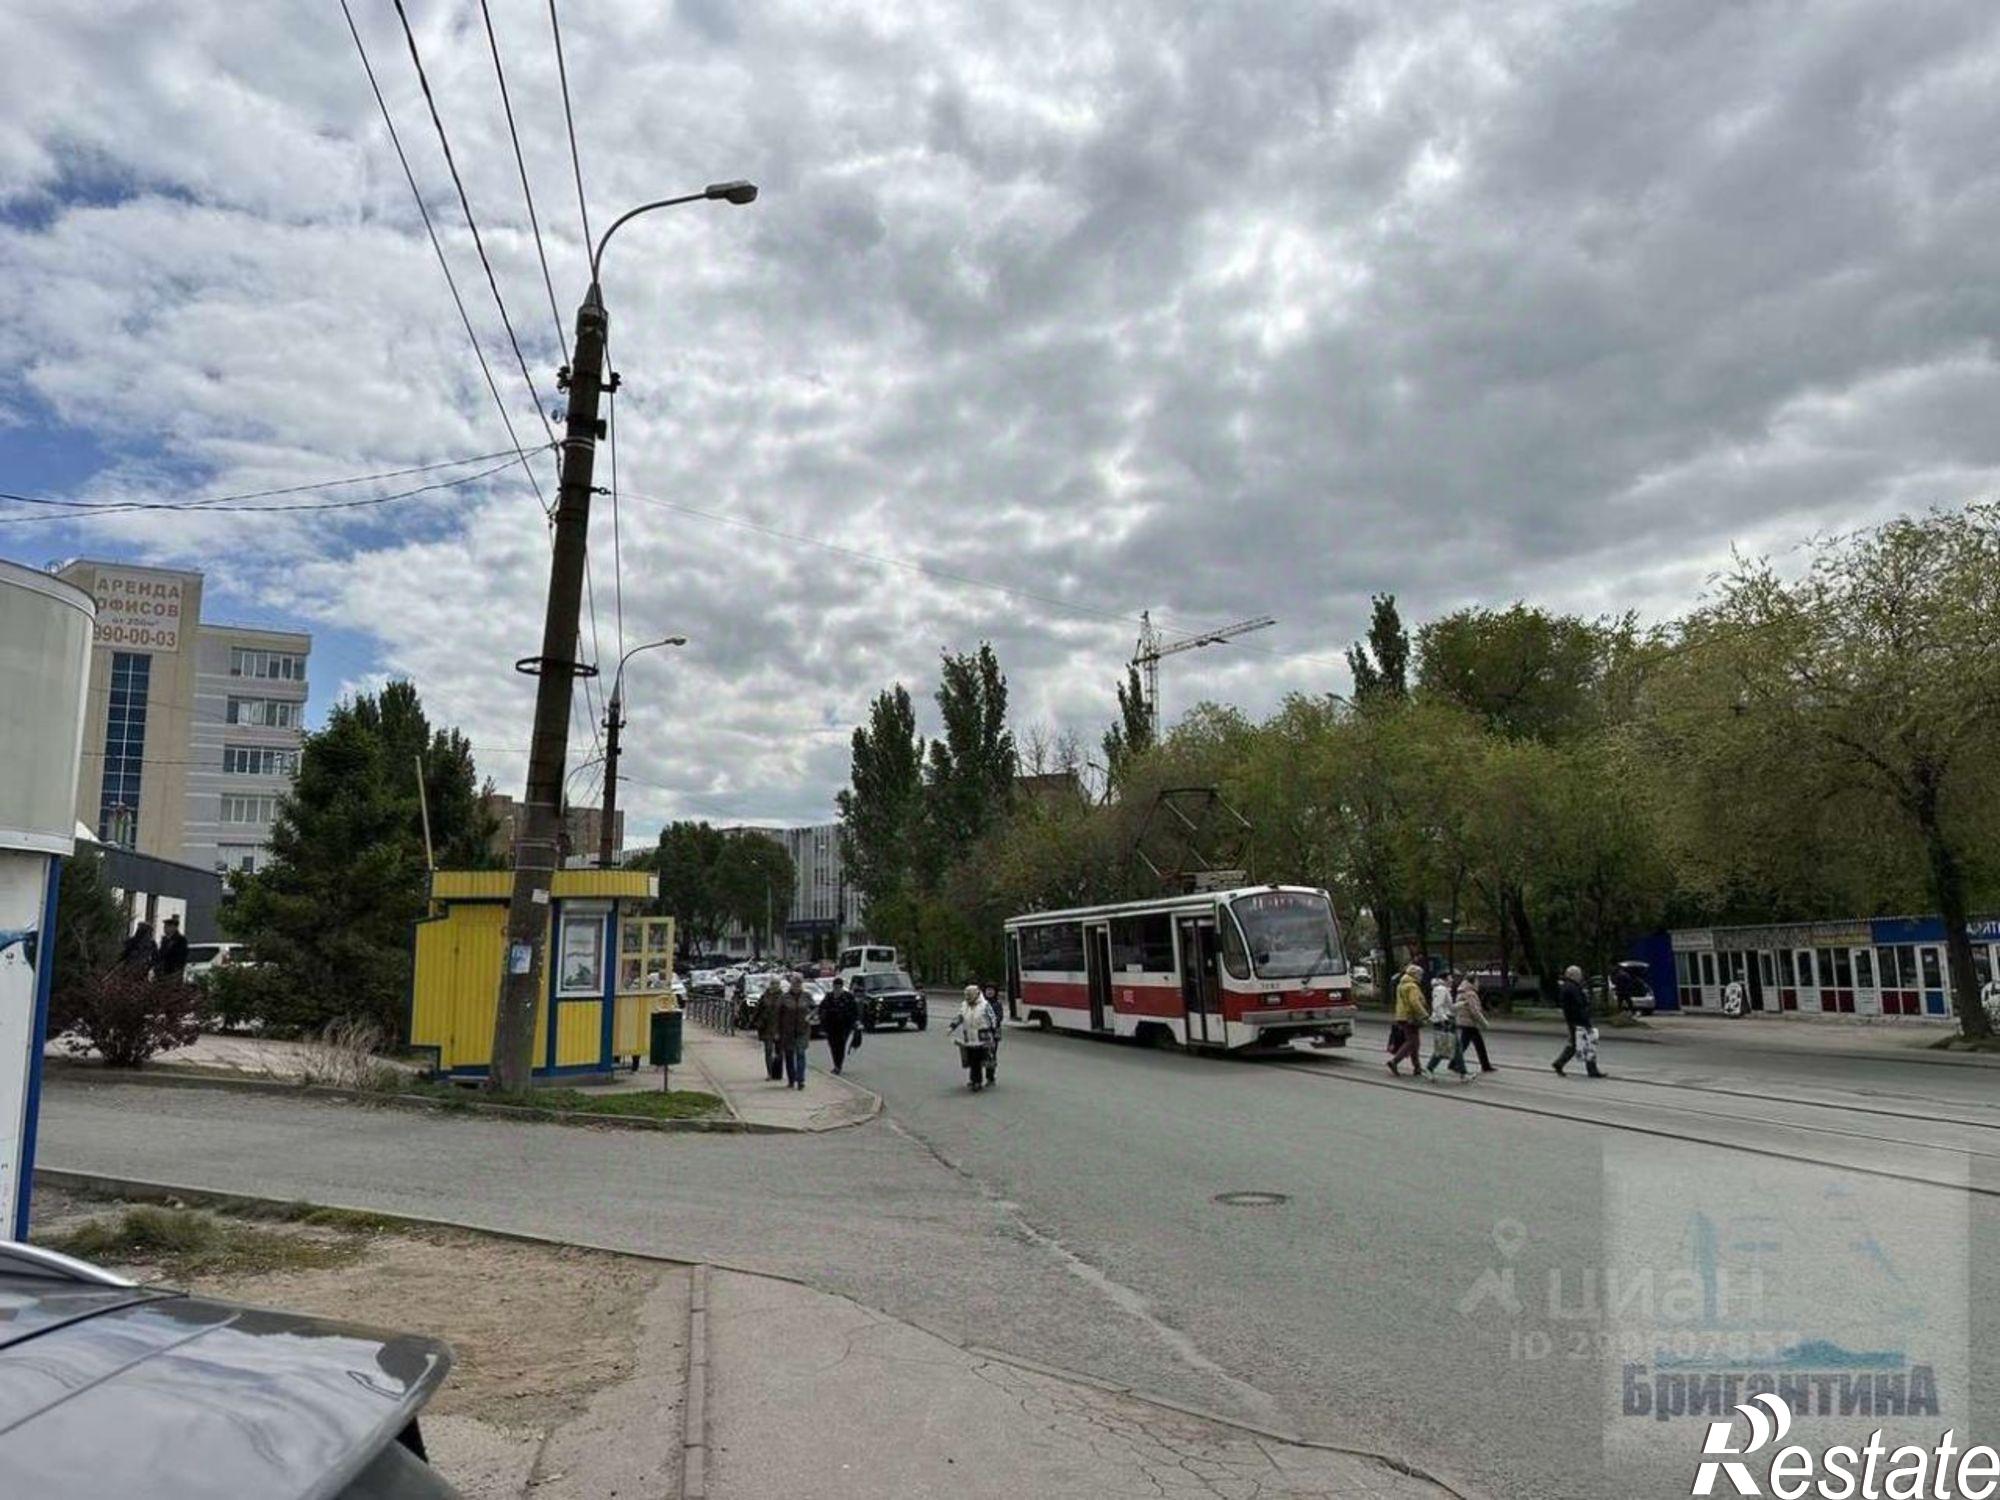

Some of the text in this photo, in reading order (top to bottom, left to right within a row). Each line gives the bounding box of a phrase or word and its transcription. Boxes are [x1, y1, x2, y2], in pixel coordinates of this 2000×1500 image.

[97, 579, 179, 599] АРЕНДА
[96, 597, 178, 617] ОФИСОВ
[93, 624, 176, 647] 990-00-03
